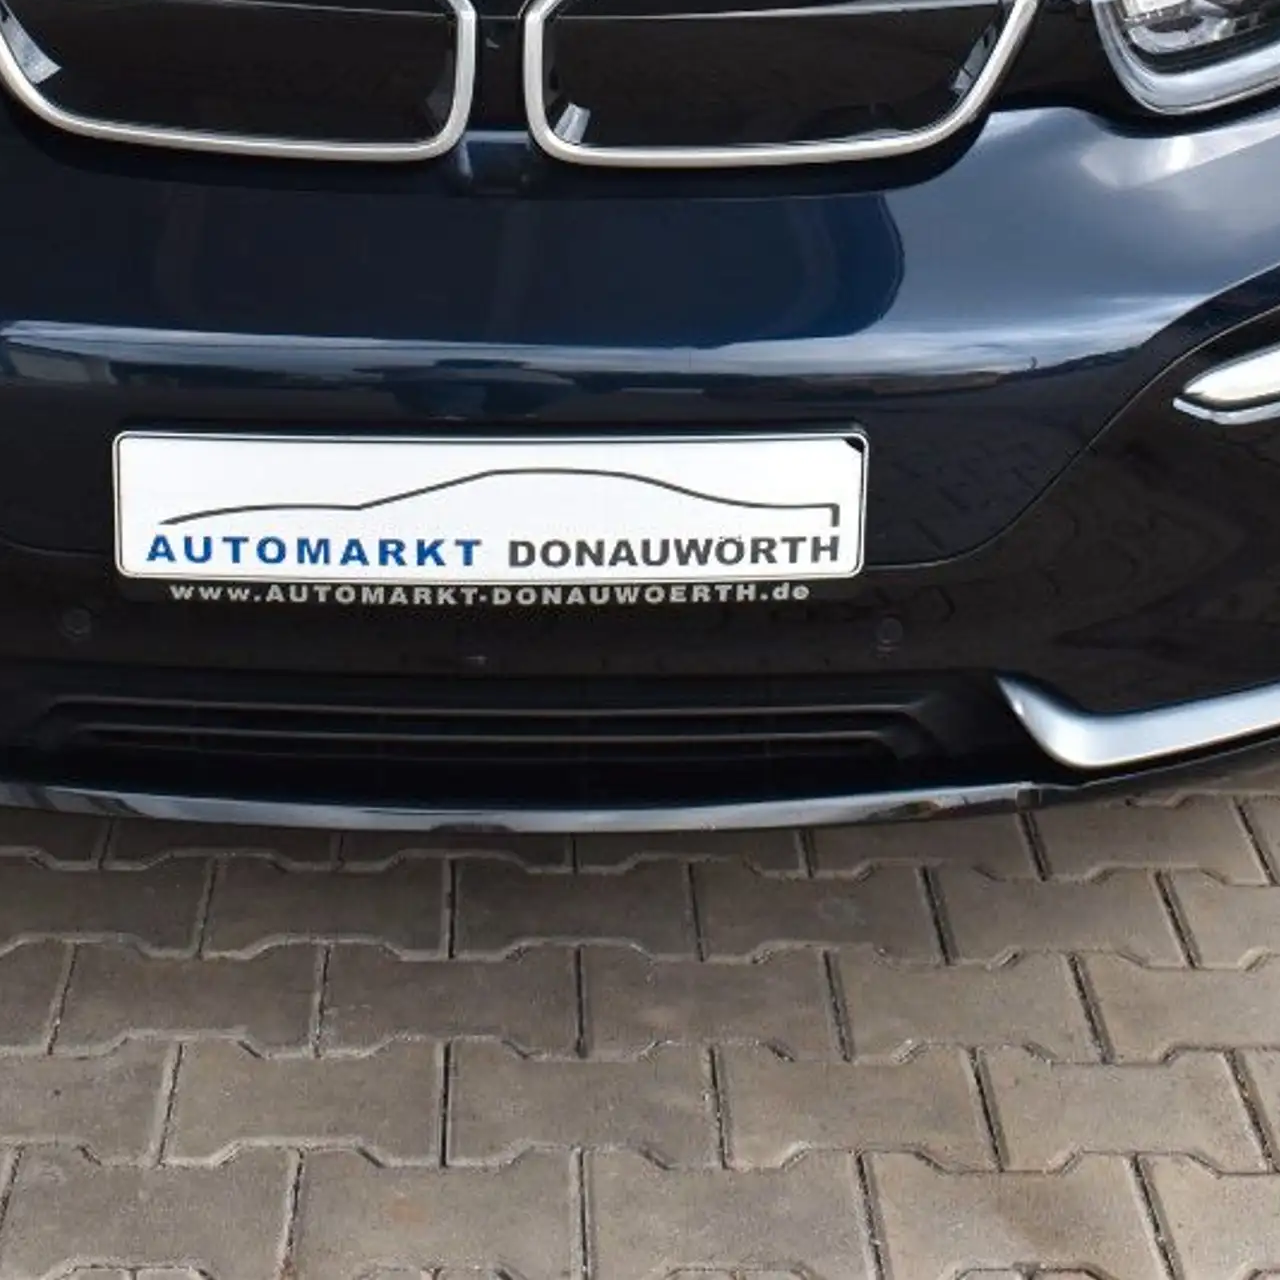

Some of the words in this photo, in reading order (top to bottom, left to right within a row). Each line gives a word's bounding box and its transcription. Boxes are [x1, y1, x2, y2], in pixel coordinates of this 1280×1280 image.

[146, 534, 483, 566] AUTOMARKT
[507, 535, 841, 568] DONAUWÖRTH
[169, 583, 810, 606] www.AUTOMARKT-DONAUWOERTH.de
